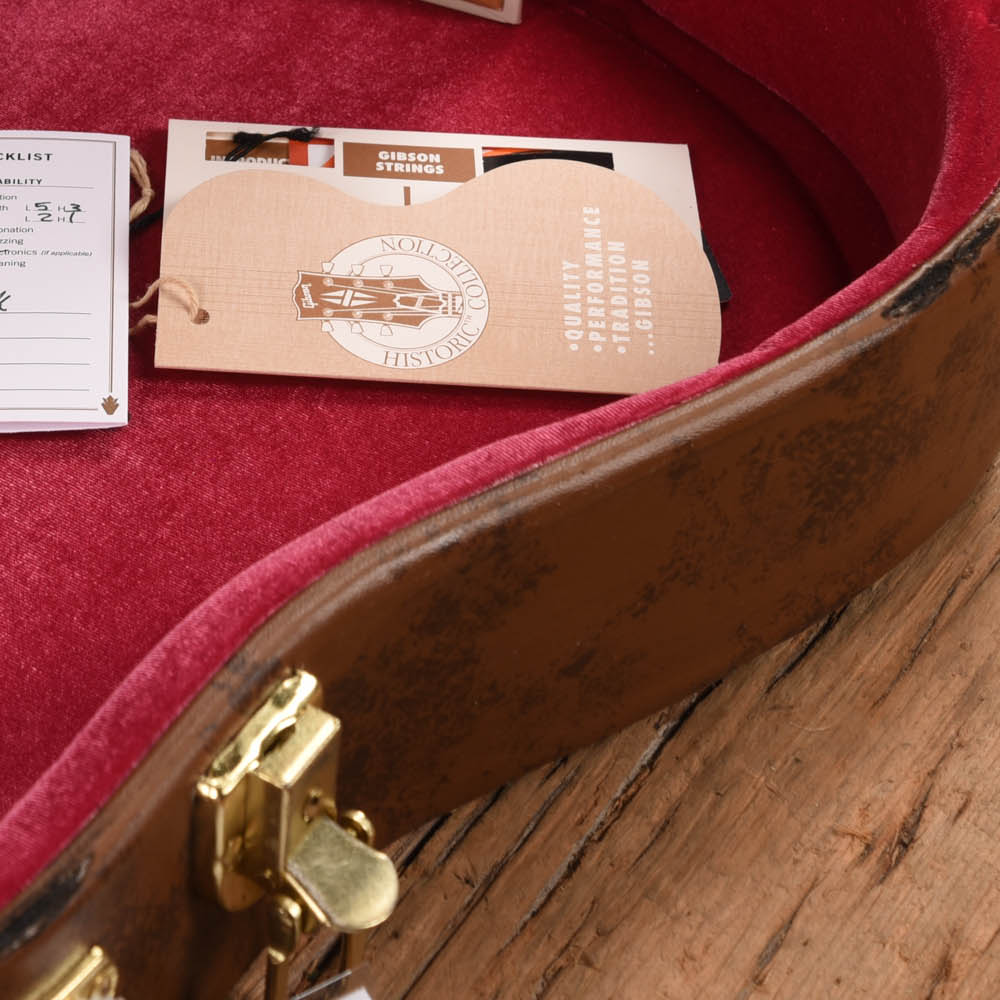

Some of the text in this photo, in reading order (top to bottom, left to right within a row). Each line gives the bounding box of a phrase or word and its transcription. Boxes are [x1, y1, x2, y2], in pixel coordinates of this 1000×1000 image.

[376, 162, 445, 175] STRINGS
[378, 150, 441, 163] GIBSON
[34, 201, 52, 211] 5
[37, 212, 54, 222] 2
[583, 206, 608, 342] PERFORMANCE
[608, 241, 632, 343] TRADITION
[381, 237, 486, 368] HISTORIC COLLECTION
[562, 259, 584, 341] QUALITY
